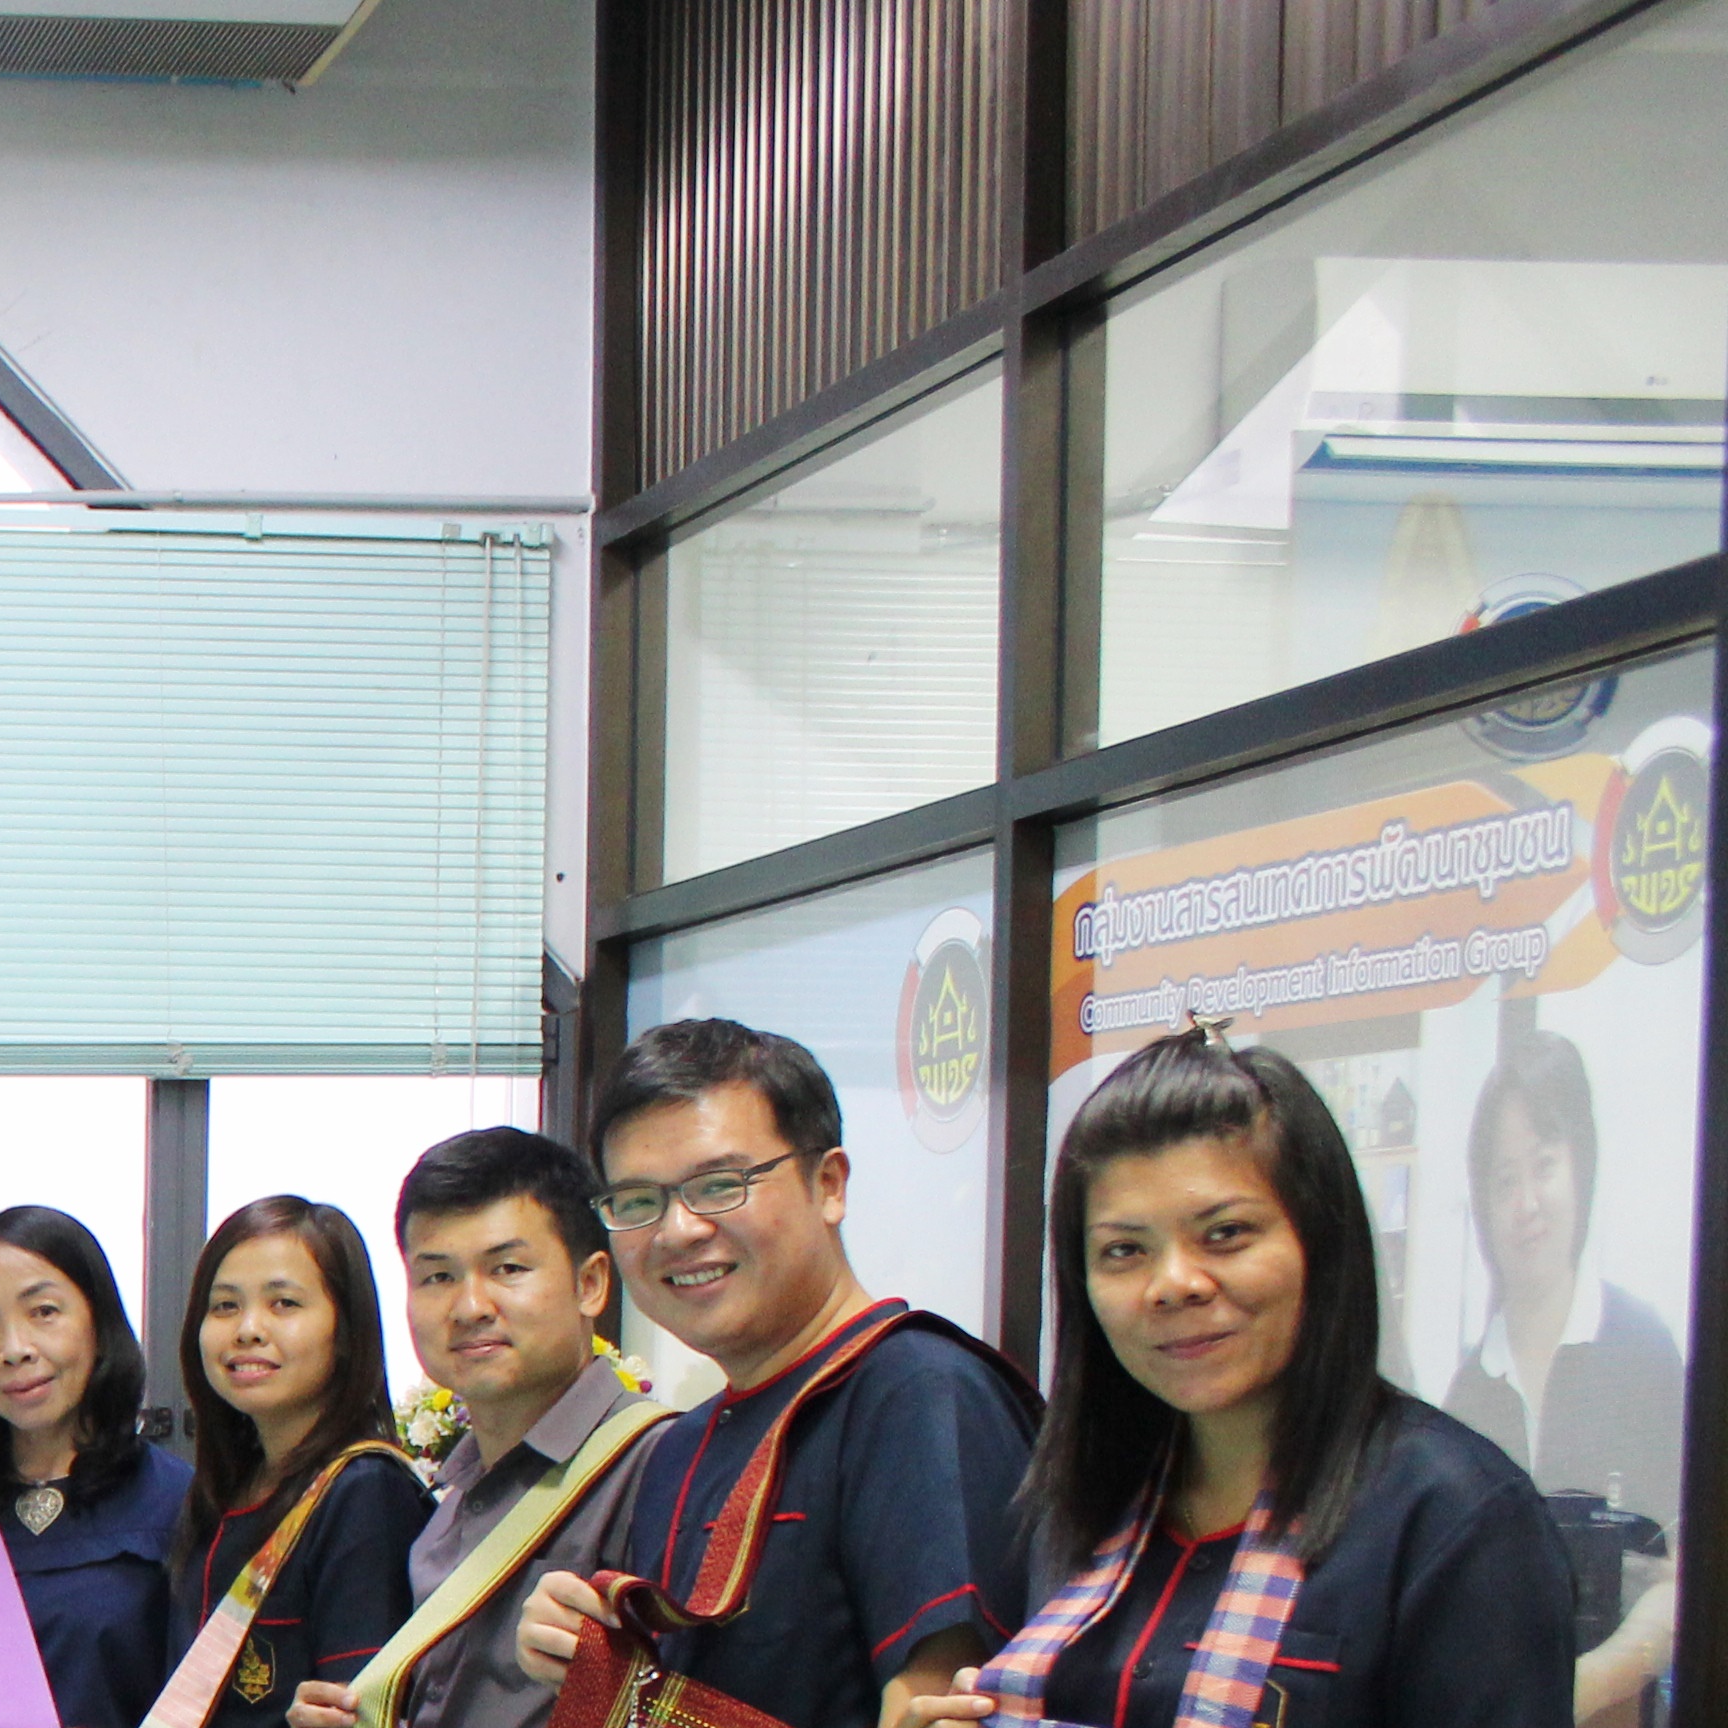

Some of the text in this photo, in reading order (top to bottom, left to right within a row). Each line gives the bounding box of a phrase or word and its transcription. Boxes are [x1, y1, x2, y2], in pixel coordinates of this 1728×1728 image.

[1079, 924, 1548, 1034] Community Development Information Group
